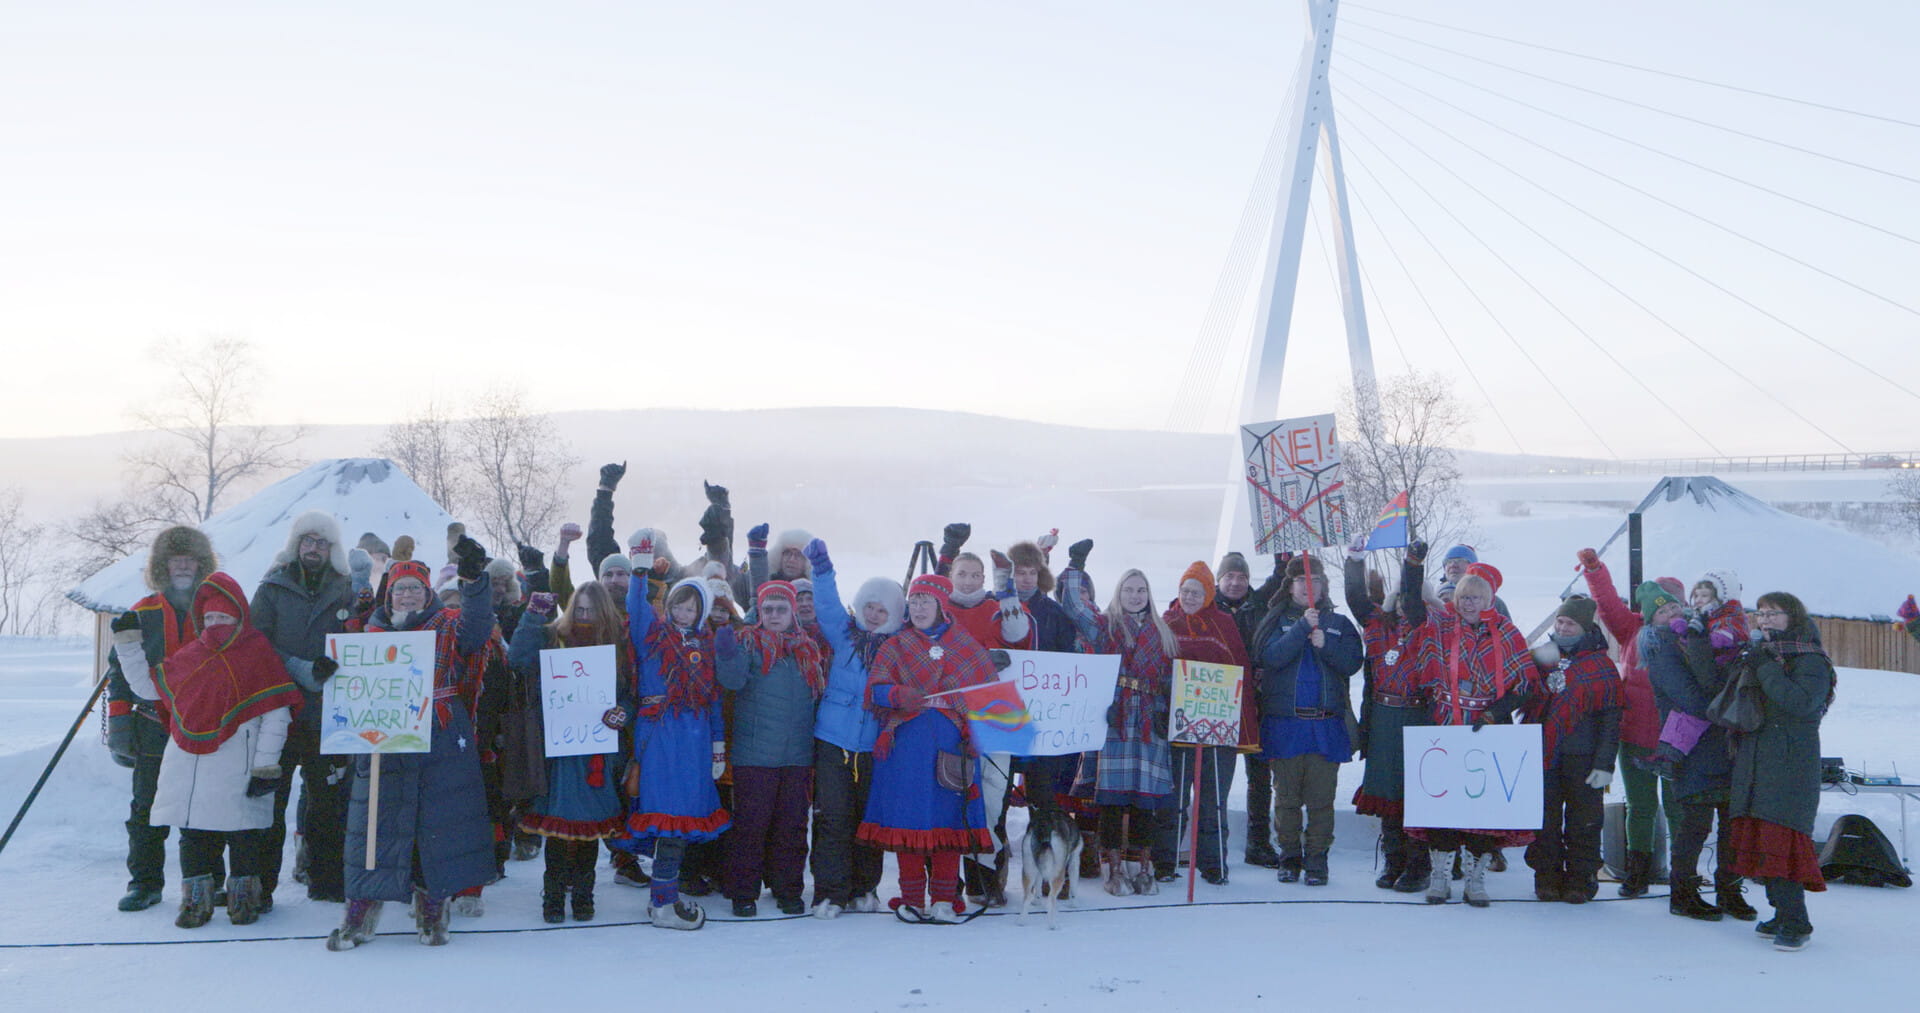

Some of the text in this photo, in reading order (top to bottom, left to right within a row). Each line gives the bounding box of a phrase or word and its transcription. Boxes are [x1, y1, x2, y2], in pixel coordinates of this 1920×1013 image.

[549, 655, 590, 680] La
[1022, 660, 1088, 696] Baajh
[549, 683, 612, 709] fjella
[1183, 700, 1236, 719] FJELLET
[550, 720, 608, 746] leve
